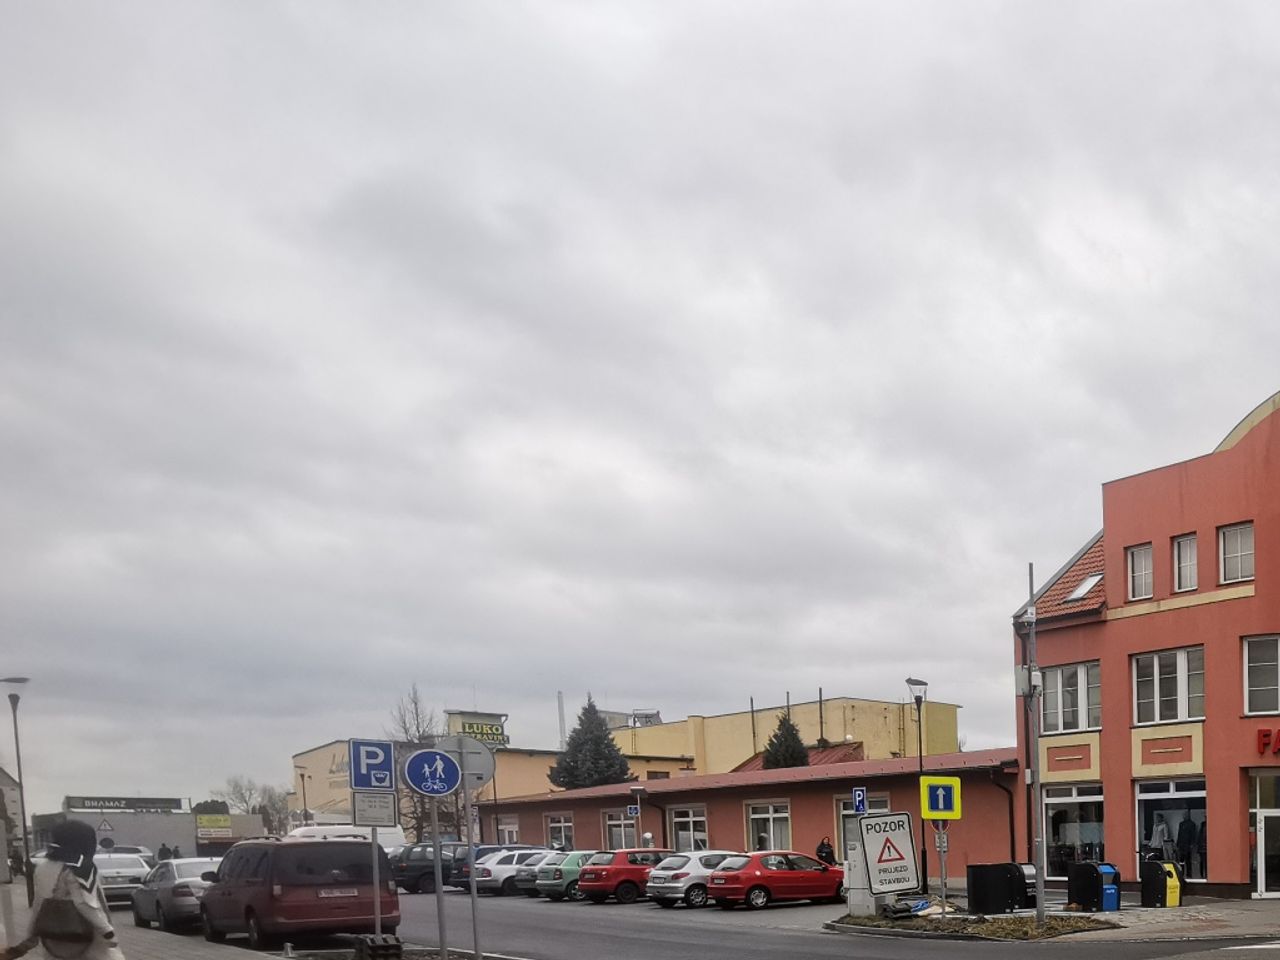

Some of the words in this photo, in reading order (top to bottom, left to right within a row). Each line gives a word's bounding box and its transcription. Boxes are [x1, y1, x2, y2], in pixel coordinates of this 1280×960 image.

[463, 722, 503, 735] LUKO
[359, 746, 385, 774] P
[855, 791, 863, 805] P
[866, 820, 906, 834] POZOR
